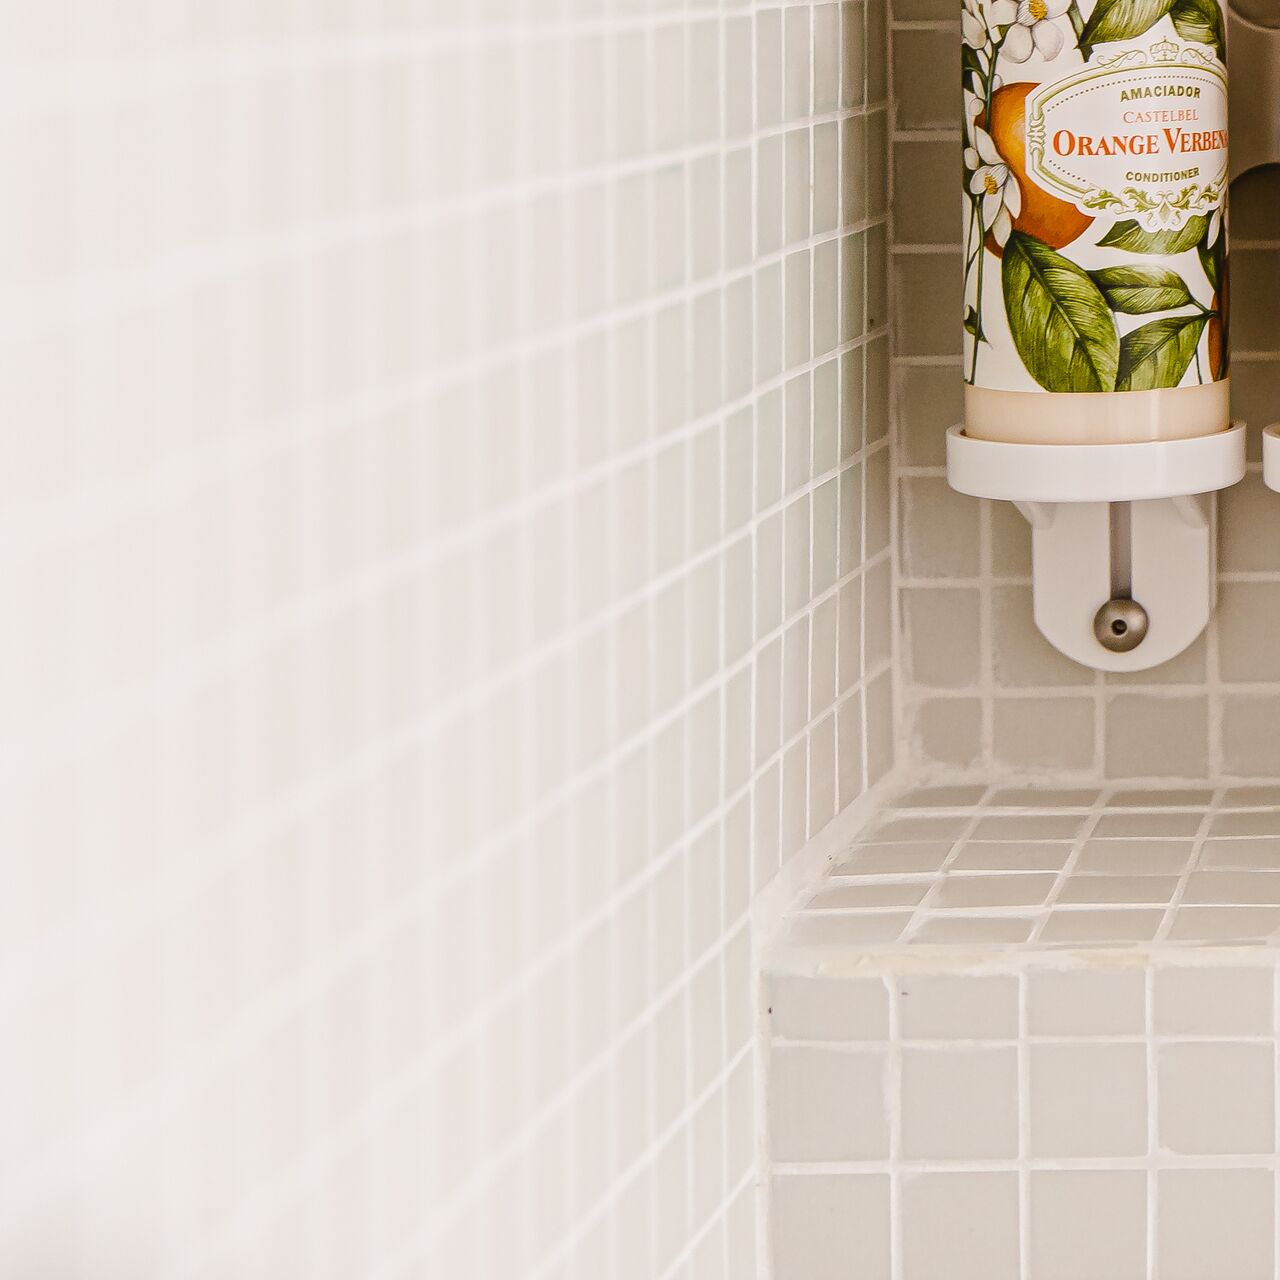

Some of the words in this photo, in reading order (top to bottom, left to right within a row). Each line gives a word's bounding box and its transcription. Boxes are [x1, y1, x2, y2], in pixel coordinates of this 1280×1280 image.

[1120, 85, 1201, 103] AMACIADOR
[1123, 109, 1199, 124] CASTELBEL
[1052, 129, 1159, 156] ORANGE
[1125, 167, 1200, 183] CONDITIONER
